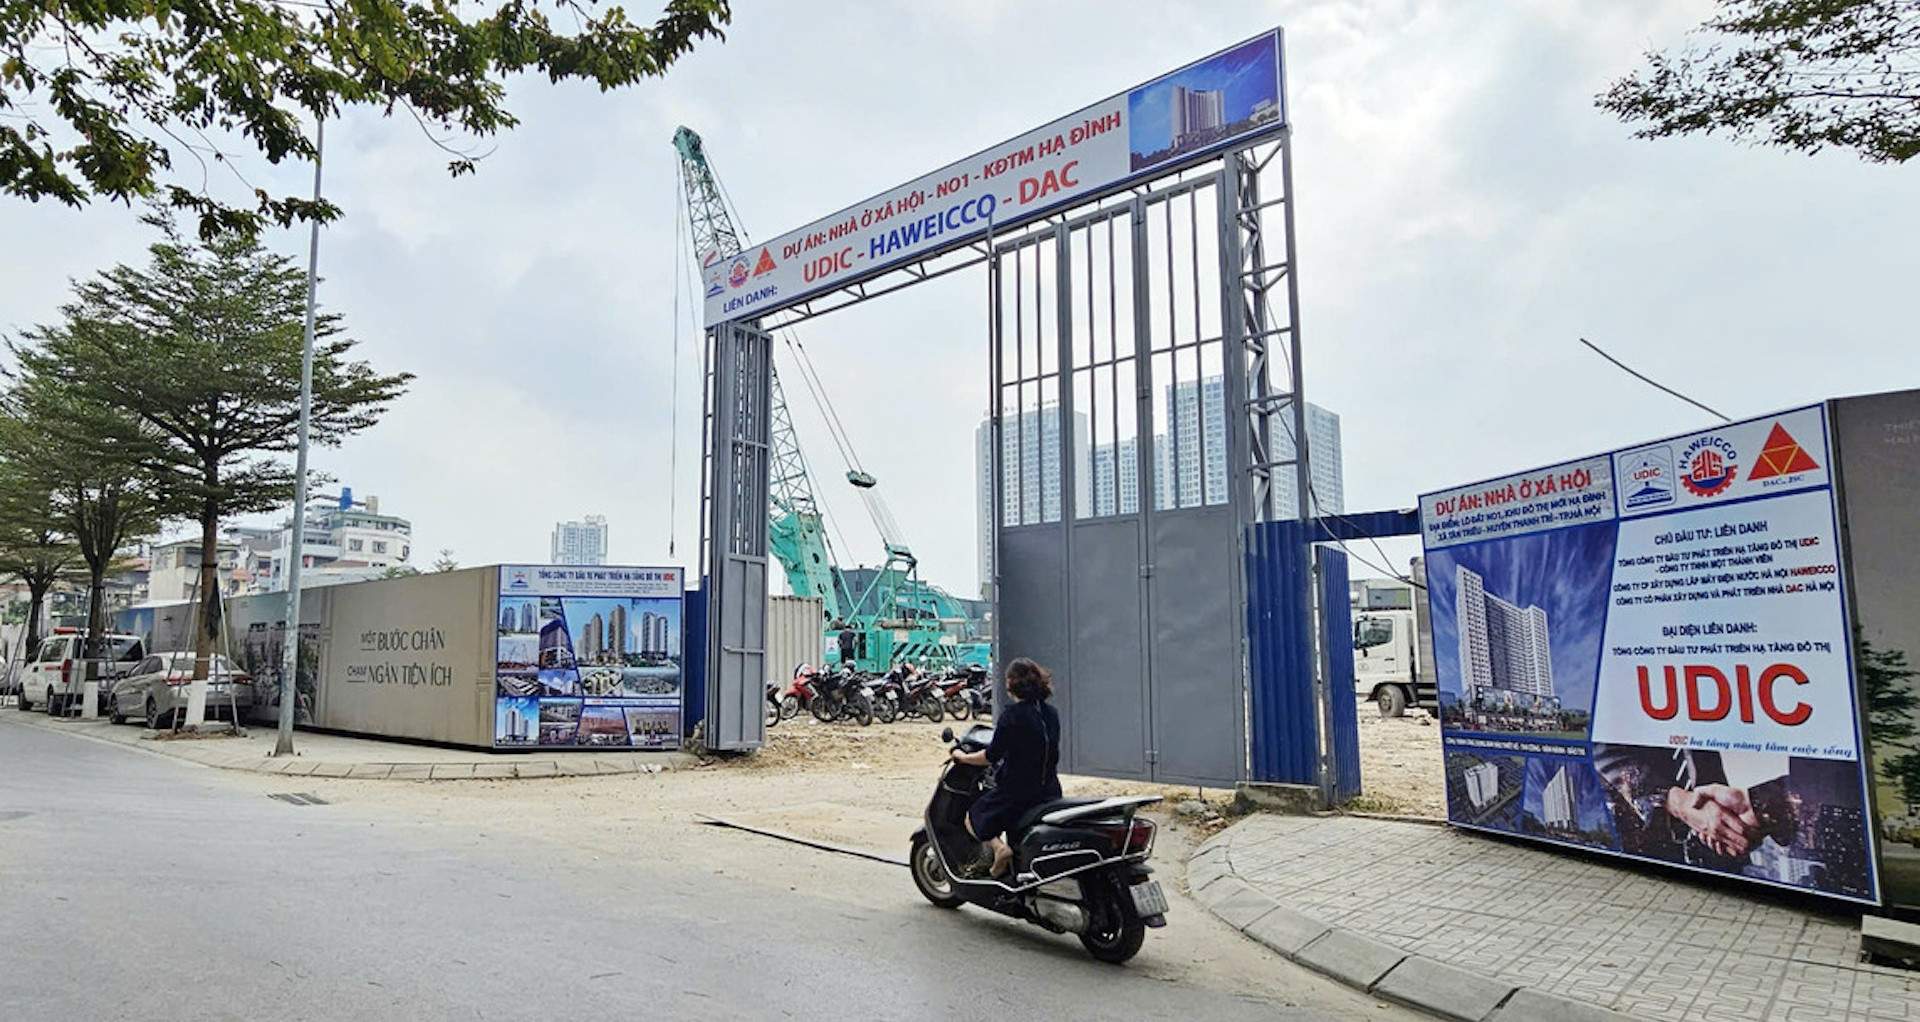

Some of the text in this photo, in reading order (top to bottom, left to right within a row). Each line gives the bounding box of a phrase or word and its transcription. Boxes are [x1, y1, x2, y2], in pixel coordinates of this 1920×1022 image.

[784, 239, 802, 259] DỰ
[804, 232, 826, 251] ÁN:
[829, 216, 857, 242] NHÀ
[861, 208, 872, 226] Ở
[874, 201, 894, 222] XÃ
[897, 190, 925, 214] HỘI
[983, 146, 1035, 180] KĐTM
[1038, 134, 1066, 159] HẠ
[1069, 110, 1122, 146] ĐÌNH
[723, 296, 744, 314] LIÊN
[746, 284, 778, 306] DANH:
[803, 246, 854, 284] UDIC
[870, 194, 996, 260] HAWEICCO
[1019, 160, 1080, 205] DAC
[1679, 436, 1737, 469] HAWEICCO
[1634, 467, 1660, 480] UDIC
[1436, 468, 1592, 518] DỰ ÁN: NHÀ Ở XÃ HỘI
[1654, 520, 1768, 546] CHỦ ĐẦU TƯ: LIÊN DANH
[1636, 556, 1654, 565] CÔNG
[1656, 555, 1664, 563] TY
[1692, 548, 1710, 558] PHÁT
[1748, 542, 1769, 552] TẦNG
[1770, 540, 1782, 550] ĐÔ
[1784, 540, 1798, 550] THỊ
[1799, 536, 1820, 547] UDIC
[1660, 564, 1678, 573] CÔNG
[1680, 563, 1689, 572] TY
[1710, 558, 1726, 568] MỘT
[1728, 556, 1754, 566] THÀNH
[1756, 553, 1773, 564] VIÊN
[1613, 582, 1631, 592] CÔNG
[1632, 582, 1640, 590] TY
[1641, 582, 1649, 590] CP
[1736, 571, 1760, 580] NƯỚC
[1761, 568, 1772, 579] HÀ
[1774, 568, 1788, 578] NỘI
[1790, 564, 1836, 577] HAWEICCO
[1616, 596, 1634, 606] CÔNG
[1634, 596, 1642, 604] TY
[1688, 591, 1708, 602] DỰNG
[1710, 588, 1720, 598] VÀ
[1722, 588, 1740, 598] PHÁT
[1743, 586, 1766, 596] TRIỂN
[1768, 583, 1784, 594] NHÀ
[1786, 583, 1804, 594] DAC
[1806, 580, 1818, 592] HÀ
[1819, 580, 1835, 592] NỘI
[412, 627, 445, 650] CHÂN
[1662, 622, 1758, 638] ĐẠI DIỆN LIÊN DANH:
[1612, 640, 1832, 656] TỔNG CÔNG TY ĐẦU TƯ PHÁT TRIỂN HẠ TẦNG ĐÔ THỊ
[402, 662, 426, 688] TIỆN
[430, 662, 452, 686] ÍCH
[1636, 662, 1814, 726] UDIC
[1669, 736, 1689, 745] UDIC
